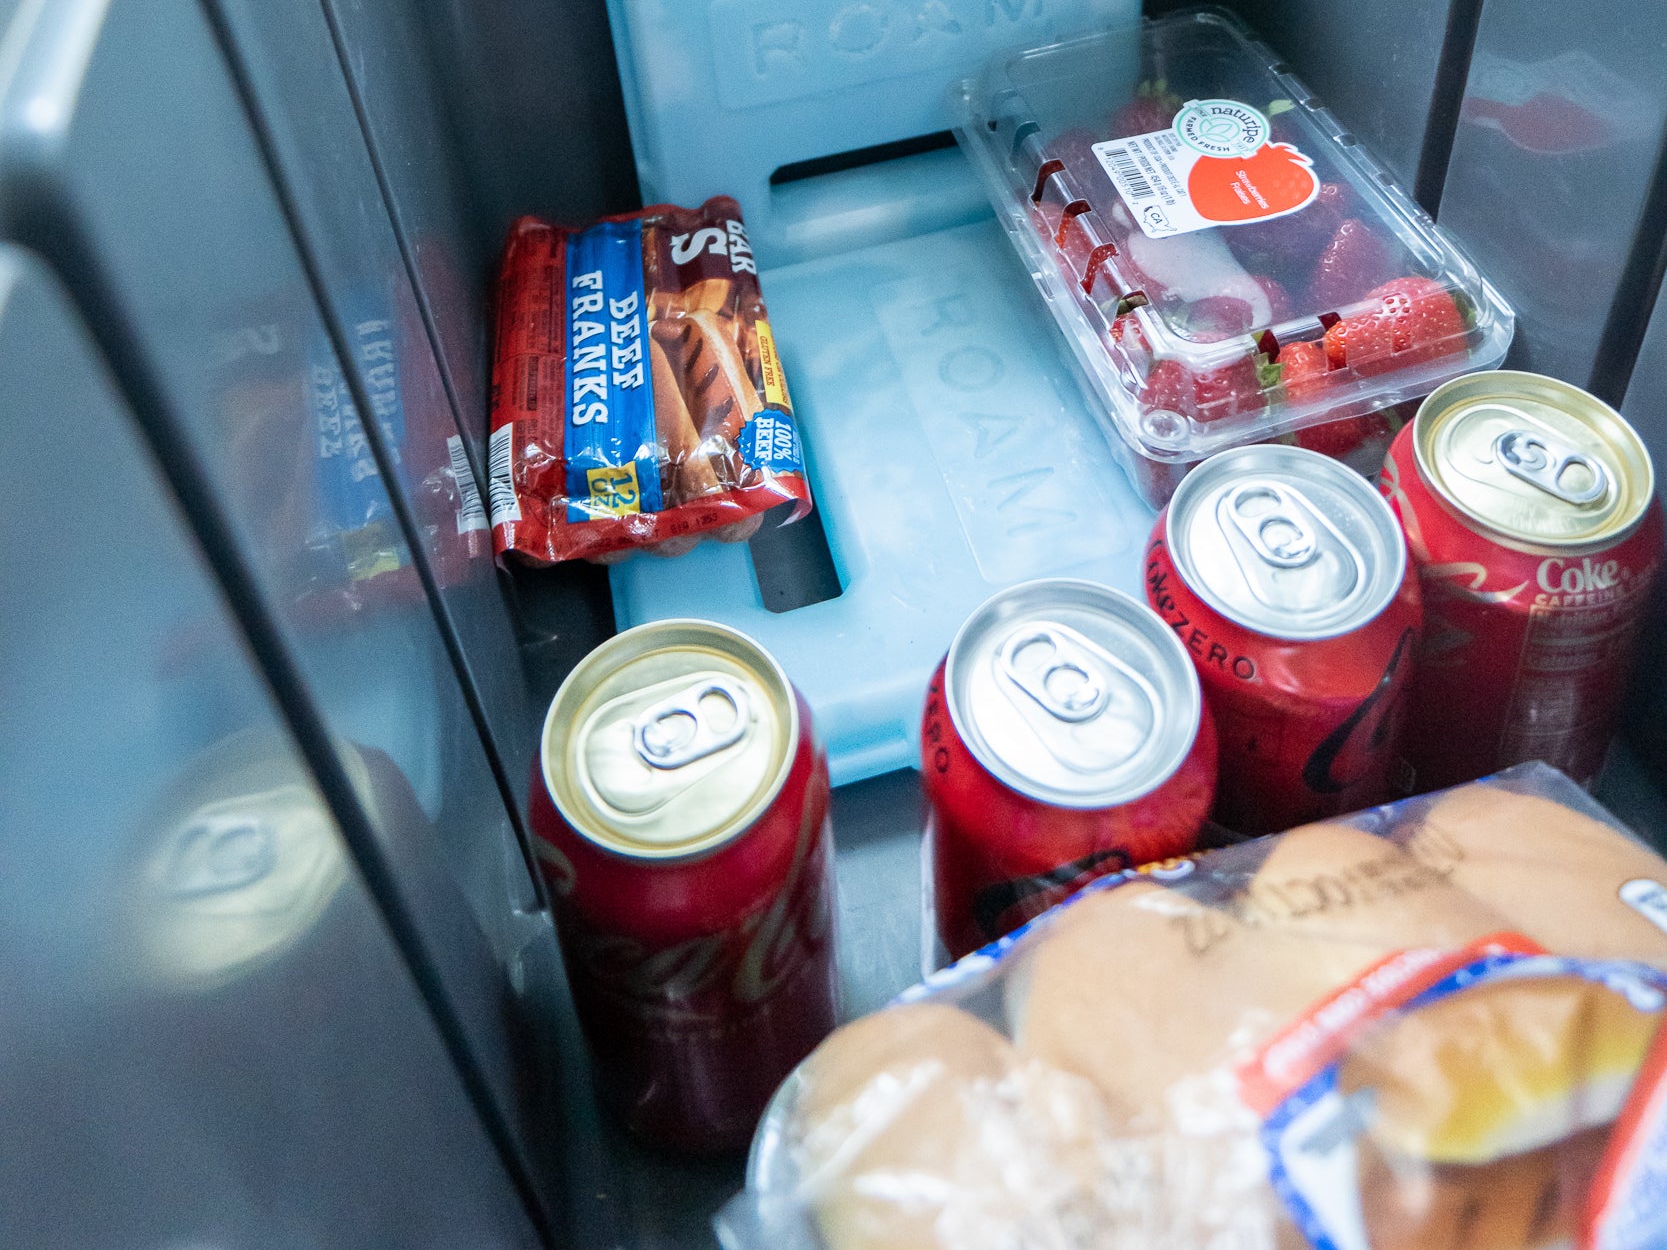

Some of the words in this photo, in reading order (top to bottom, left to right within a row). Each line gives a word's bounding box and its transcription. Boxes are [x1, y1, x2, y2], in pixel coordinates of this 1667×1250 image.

[1210, 106, 1262, 144] naturipe
[1197, 141, 1230, 152] FRESH
[1230, 181, 1251, 205] Fraises
[1235, 170, 1270, 210] Strawberries
[1150, 212, 1163, 224] CA
[671, 227, 728, 266] S
[726, 219, 757, 276] BAR
[572, 270, 609, 426] FRANKS
[609, 291, 645, 390] BEEF
[760, 335, 770, 366] GLUTEN
[765, 366, 775, 387] FREE
[910, 292, 1078, 538] ROAM
[754, 417, 775, 461] BEEF
[774, 421, 793, 461] 100%
[591, 478, 610, 510] OZ
[612, 472, 636, 509] 12
[1536, 557, 1619, 594] Coke
[1171, 611, 1256, 680] ZERO
